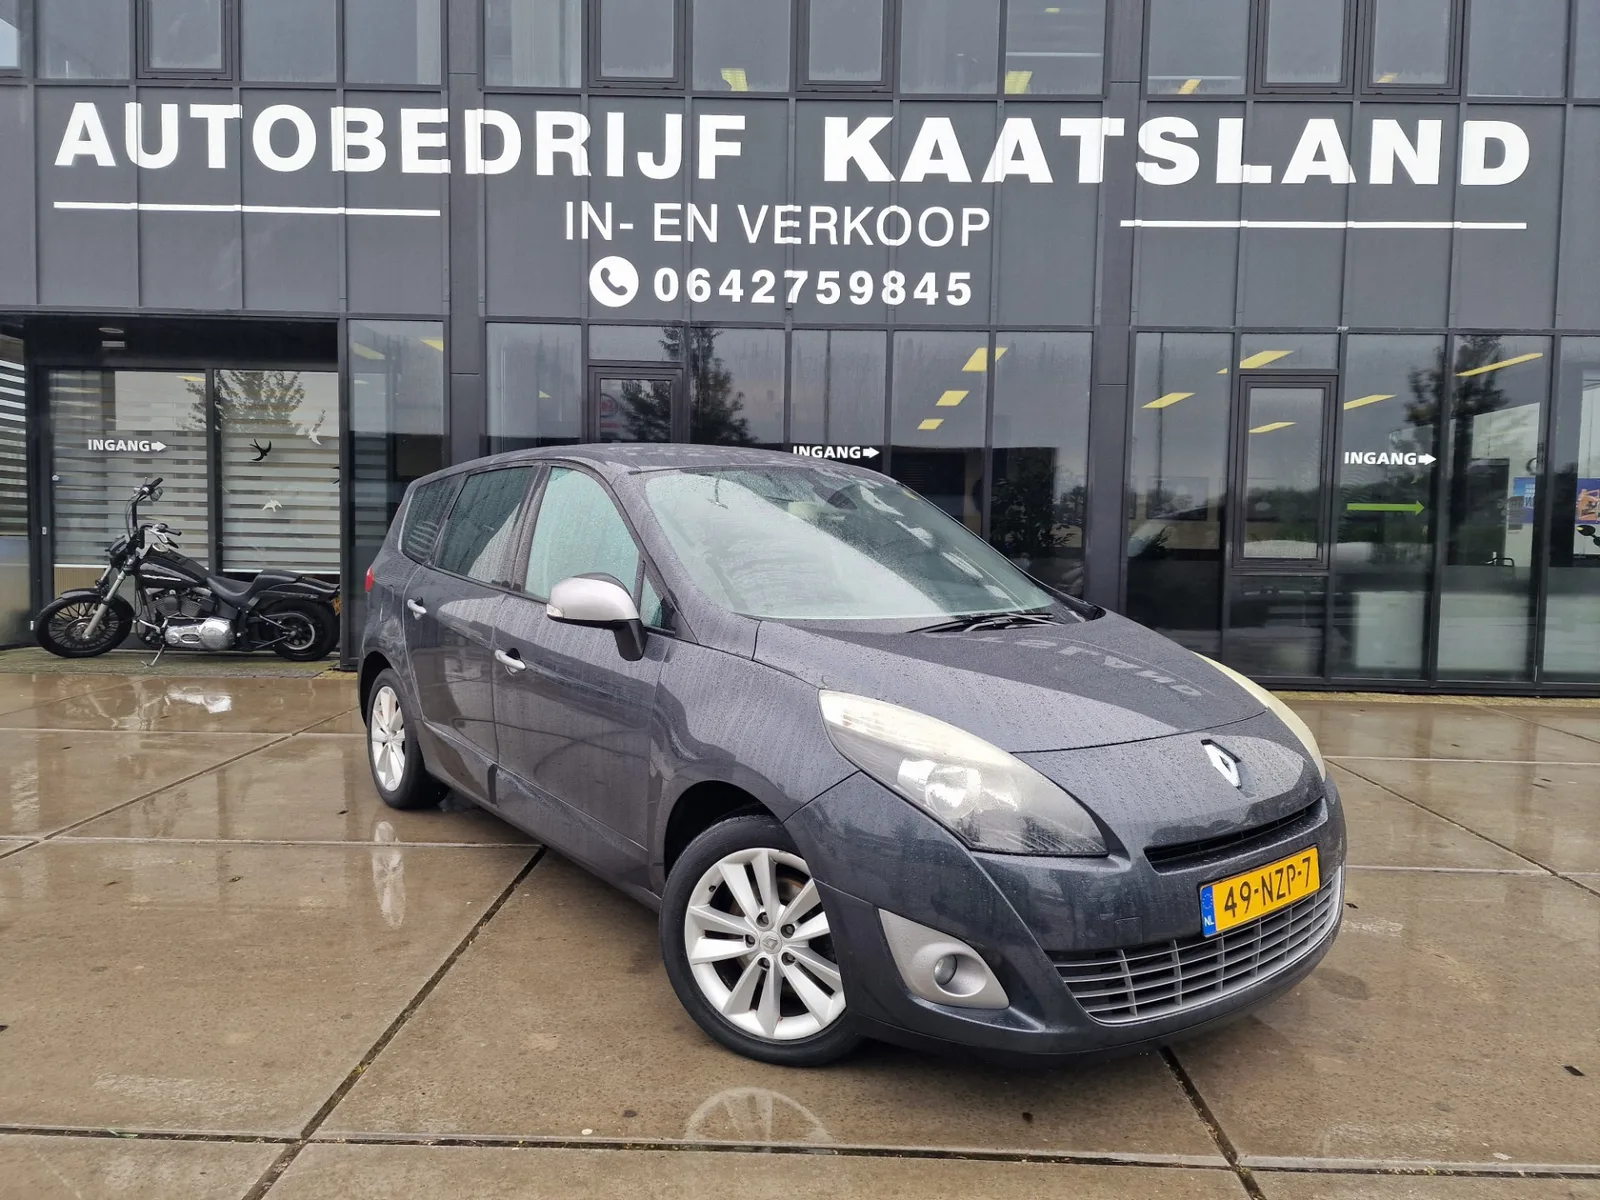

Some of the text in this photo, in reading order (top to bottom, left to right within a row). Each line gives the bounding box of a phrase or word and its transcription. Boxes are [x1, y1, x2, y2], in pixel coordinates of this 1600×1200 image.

[54, 101, 1531, 187] AUTOBEDRIJF KAATSLAND
[565, 200, 991, 248] IN- EN VERKOOP
[653, 267, 972, 307] 0642759845
[87, 439, 150, 452] INGANG
[792, 445, 861, 459] INGANG
[1343, 451, 1417, 466] INGANG
[1224, 856, 1311, 918] 49-NZP-7
[1204, 915, 1214, 927] NL
